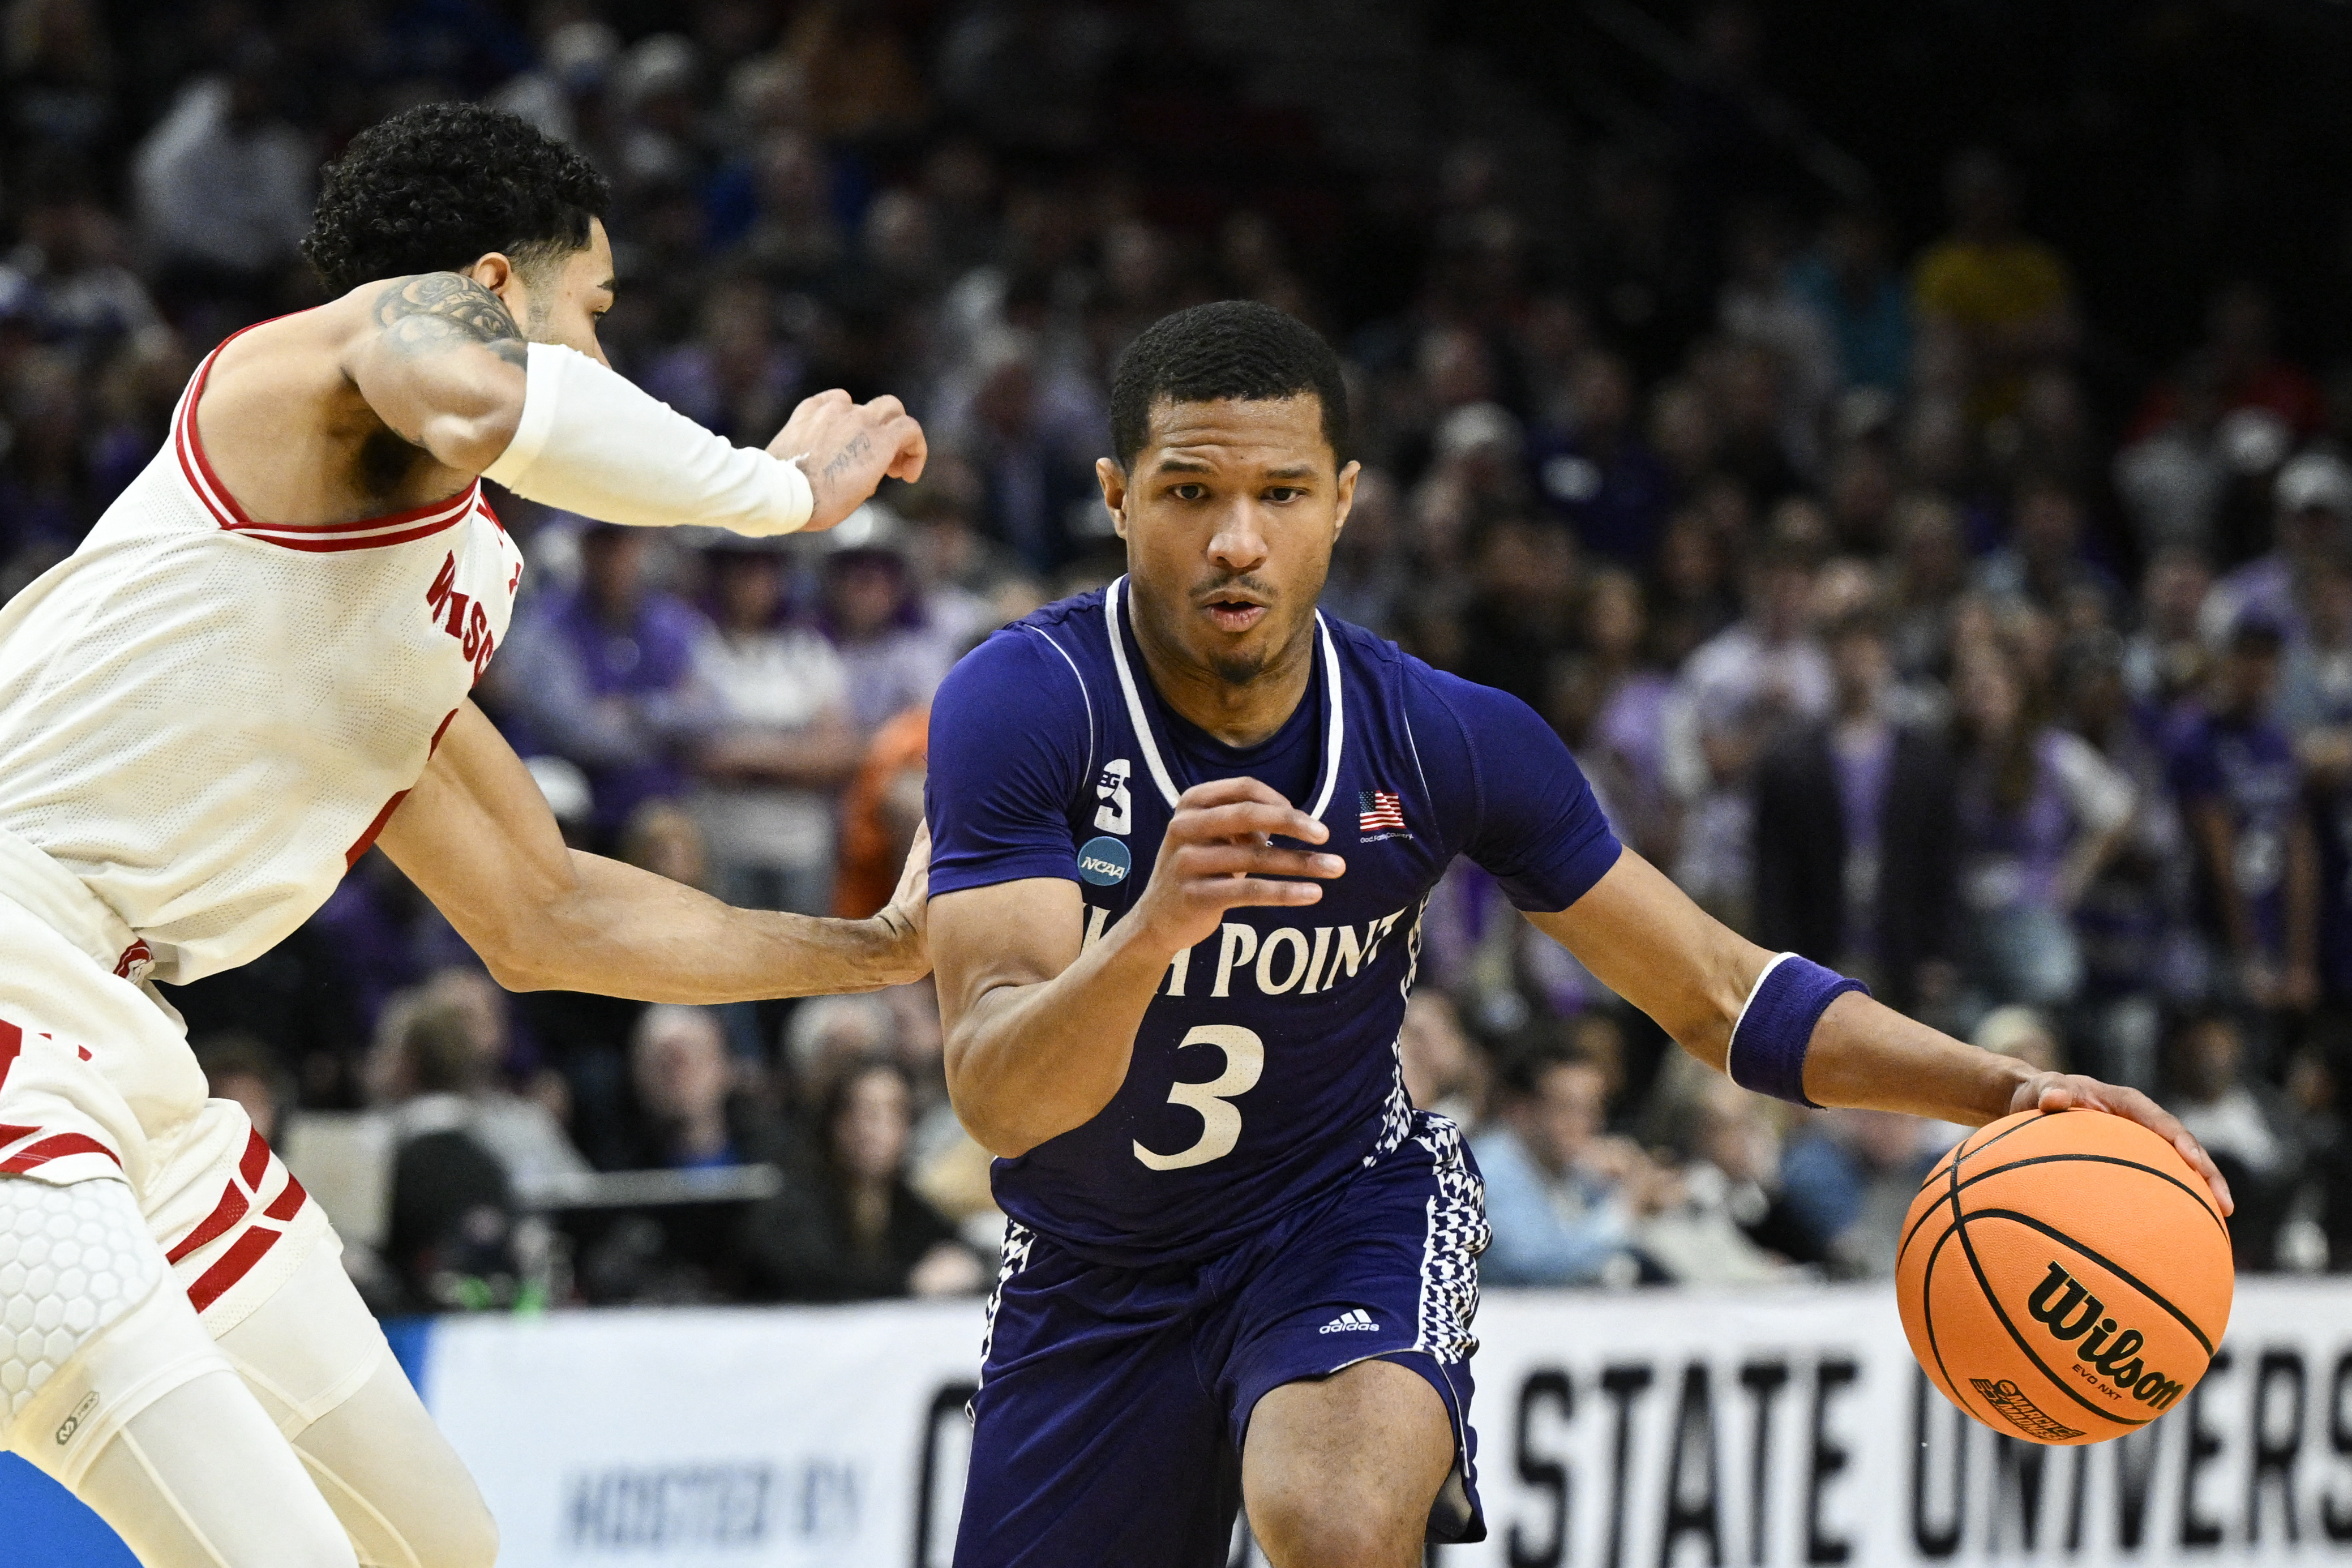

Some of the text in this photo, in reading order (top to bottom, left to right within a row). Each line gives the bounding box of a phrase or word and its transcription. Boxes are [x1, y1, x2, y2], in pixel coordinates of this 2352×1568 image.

[1081, 856, 1125, 879] NCAA
[1210, 906, 1408, 997] POINT
[1133, 1024, 1265, 1171] 3
[1319, 1322, 1380, 1334] adidas
[2028, 1259, 2184, 1411] Wilson
[2072, 1364, 2122, 1400] EVO NXT
[1997, 1404, 2067, 1440] MADNESS
[2007, 1395, 2060, 1429] MARCH
[1507, 1359, 1858, 1568] STATE
